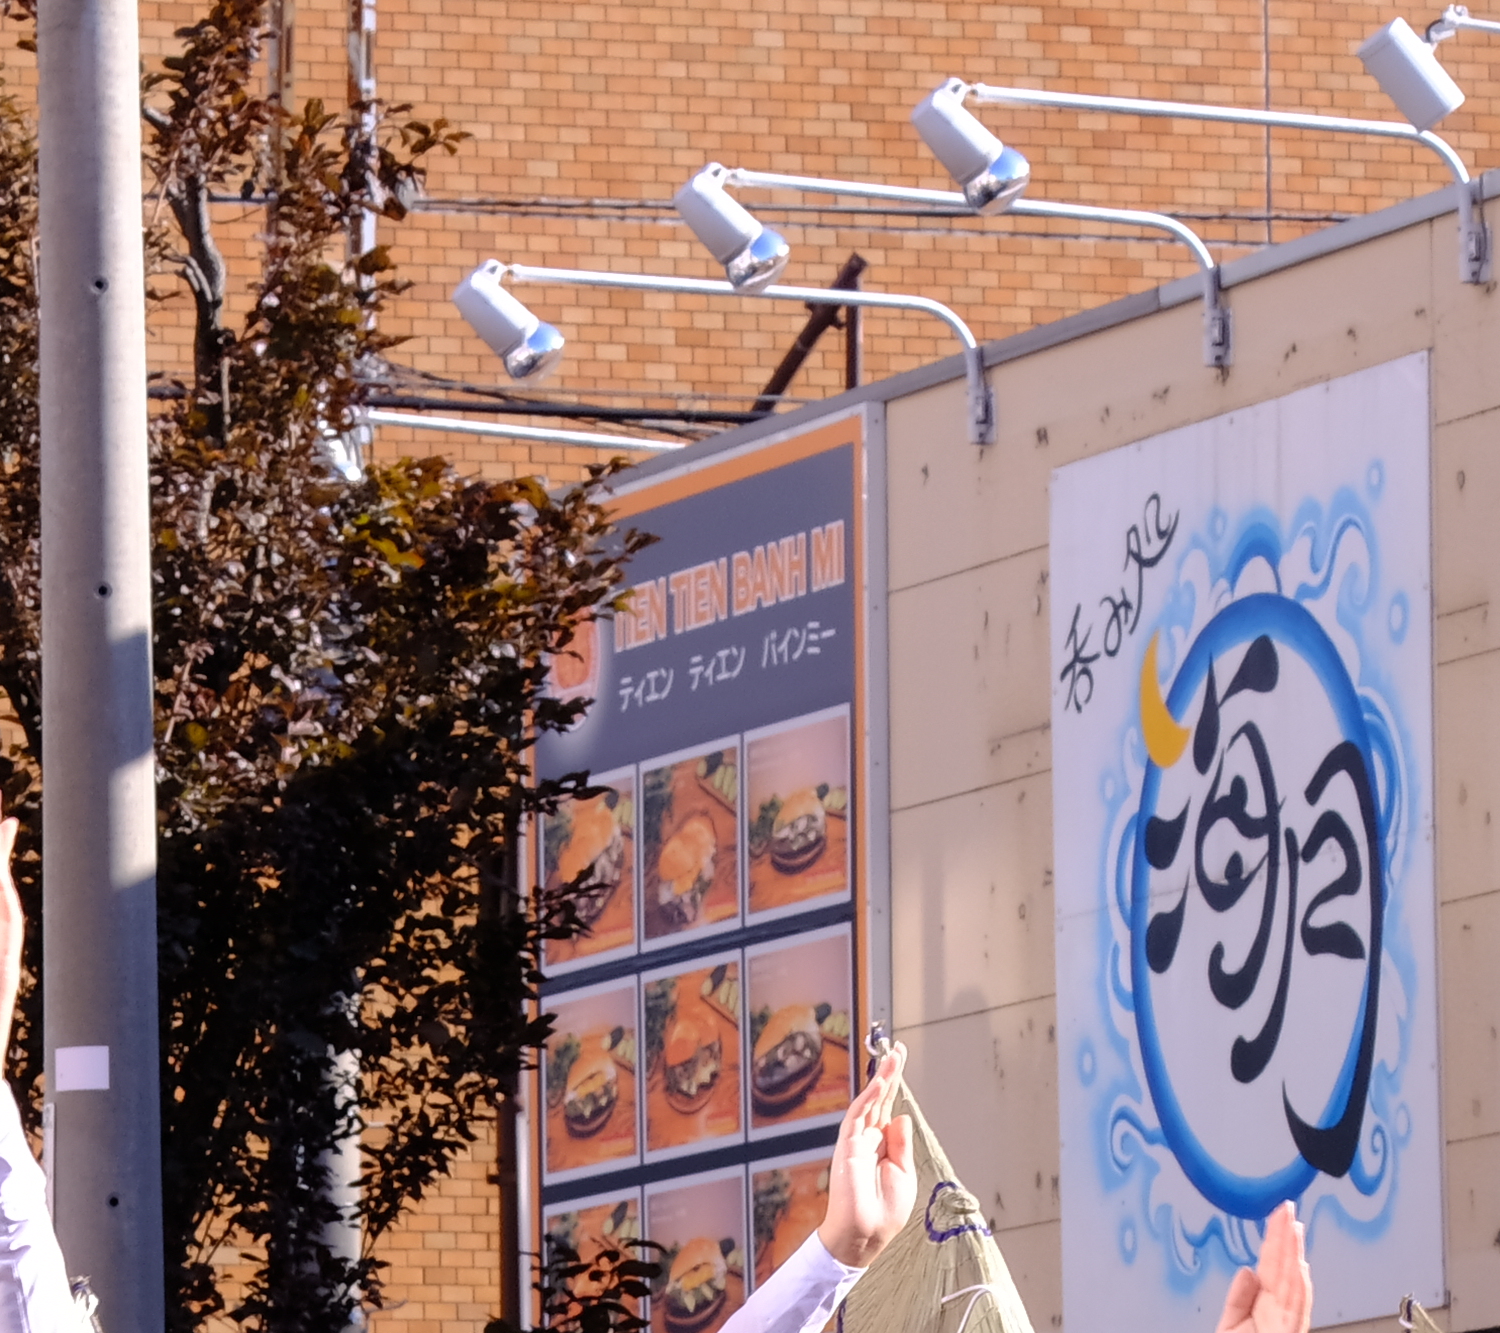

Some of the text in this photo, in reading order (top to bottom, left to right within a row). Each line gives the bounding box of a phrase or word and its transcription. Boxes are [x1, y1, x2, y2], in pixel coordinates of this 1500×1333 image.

[669, 556, 729, 636] TIEN
[731, 532, 808, 617] BANH
[810, 518, 846, 593] MI
[618, 667, 674, 714] ティエン
[689, 644, 747, 691] ティエン
